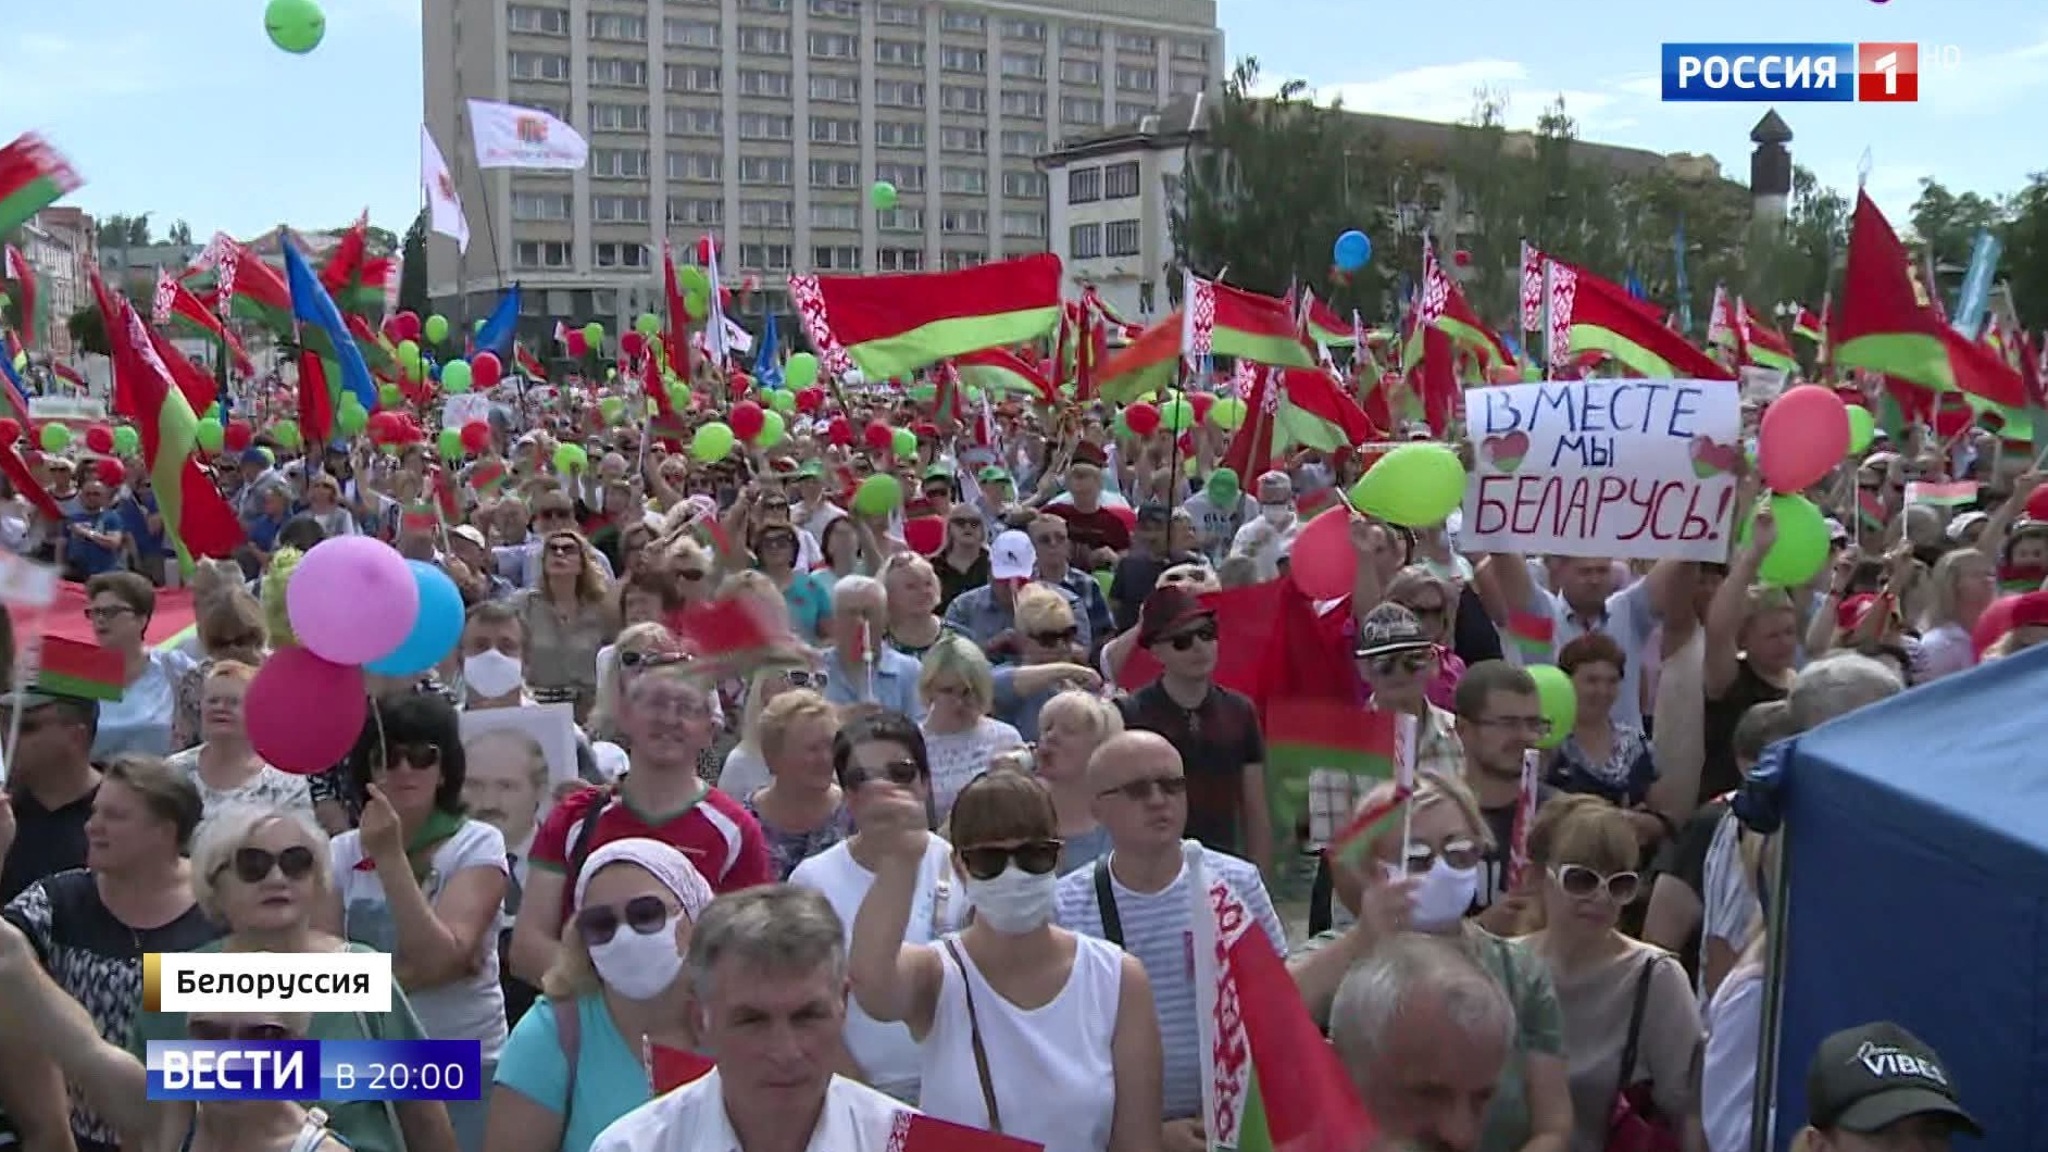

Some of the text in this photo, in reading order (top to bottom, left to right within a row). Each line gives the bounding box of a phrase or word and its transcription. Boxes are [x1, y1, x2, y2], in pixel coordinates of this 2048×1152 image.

[1485, 384, 1702, 438] ВМЕСТЕ
[1551, 435, 1614, 467] МЫ
[1475, 475, 1733, 540] БЕЛАРУСЬ!
